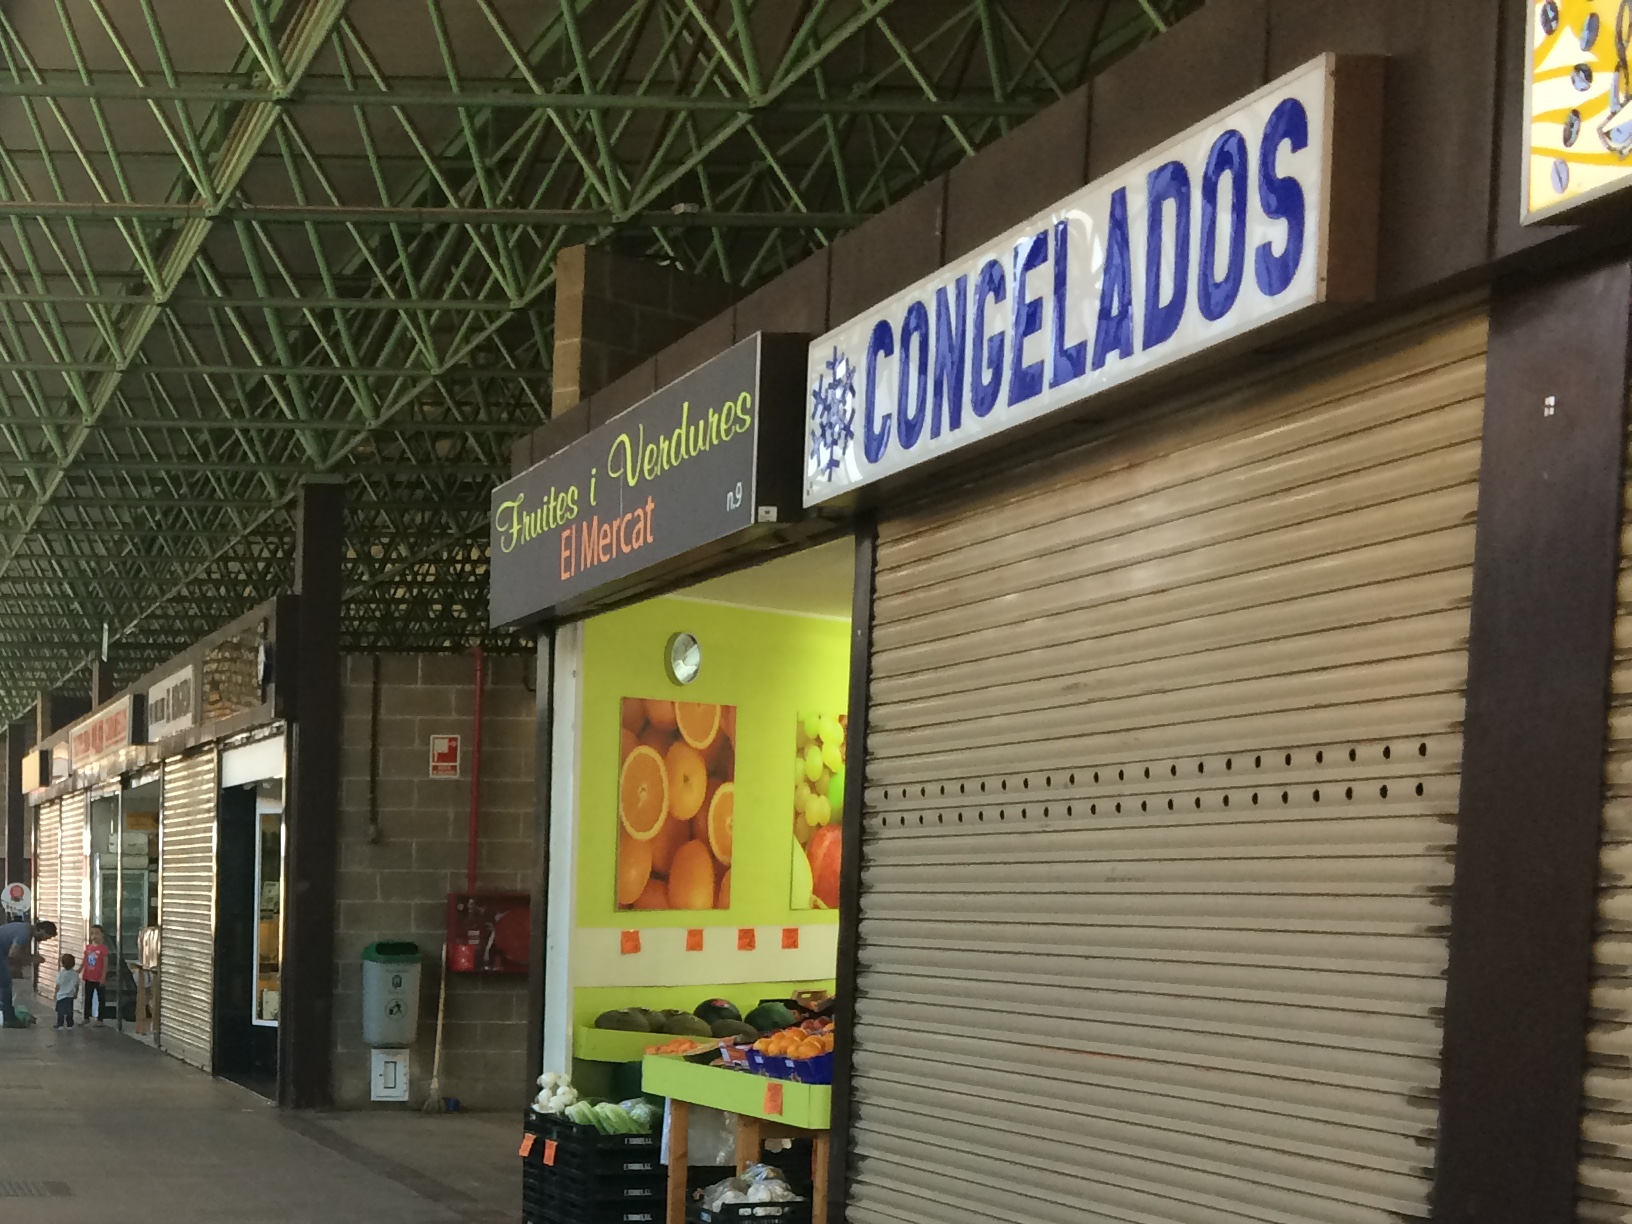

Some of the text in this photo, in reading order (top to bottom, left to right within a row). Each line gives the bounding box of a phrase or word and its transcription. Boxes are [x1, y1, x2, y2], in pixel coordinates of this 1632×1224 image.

[863, 97, 1309, 464] CONGELADOS
[495, 391, 752, 553] Fruites i Verdures
[726, 481, 743, 512] n.9
[559, 495, 655, 581] El Mercat
